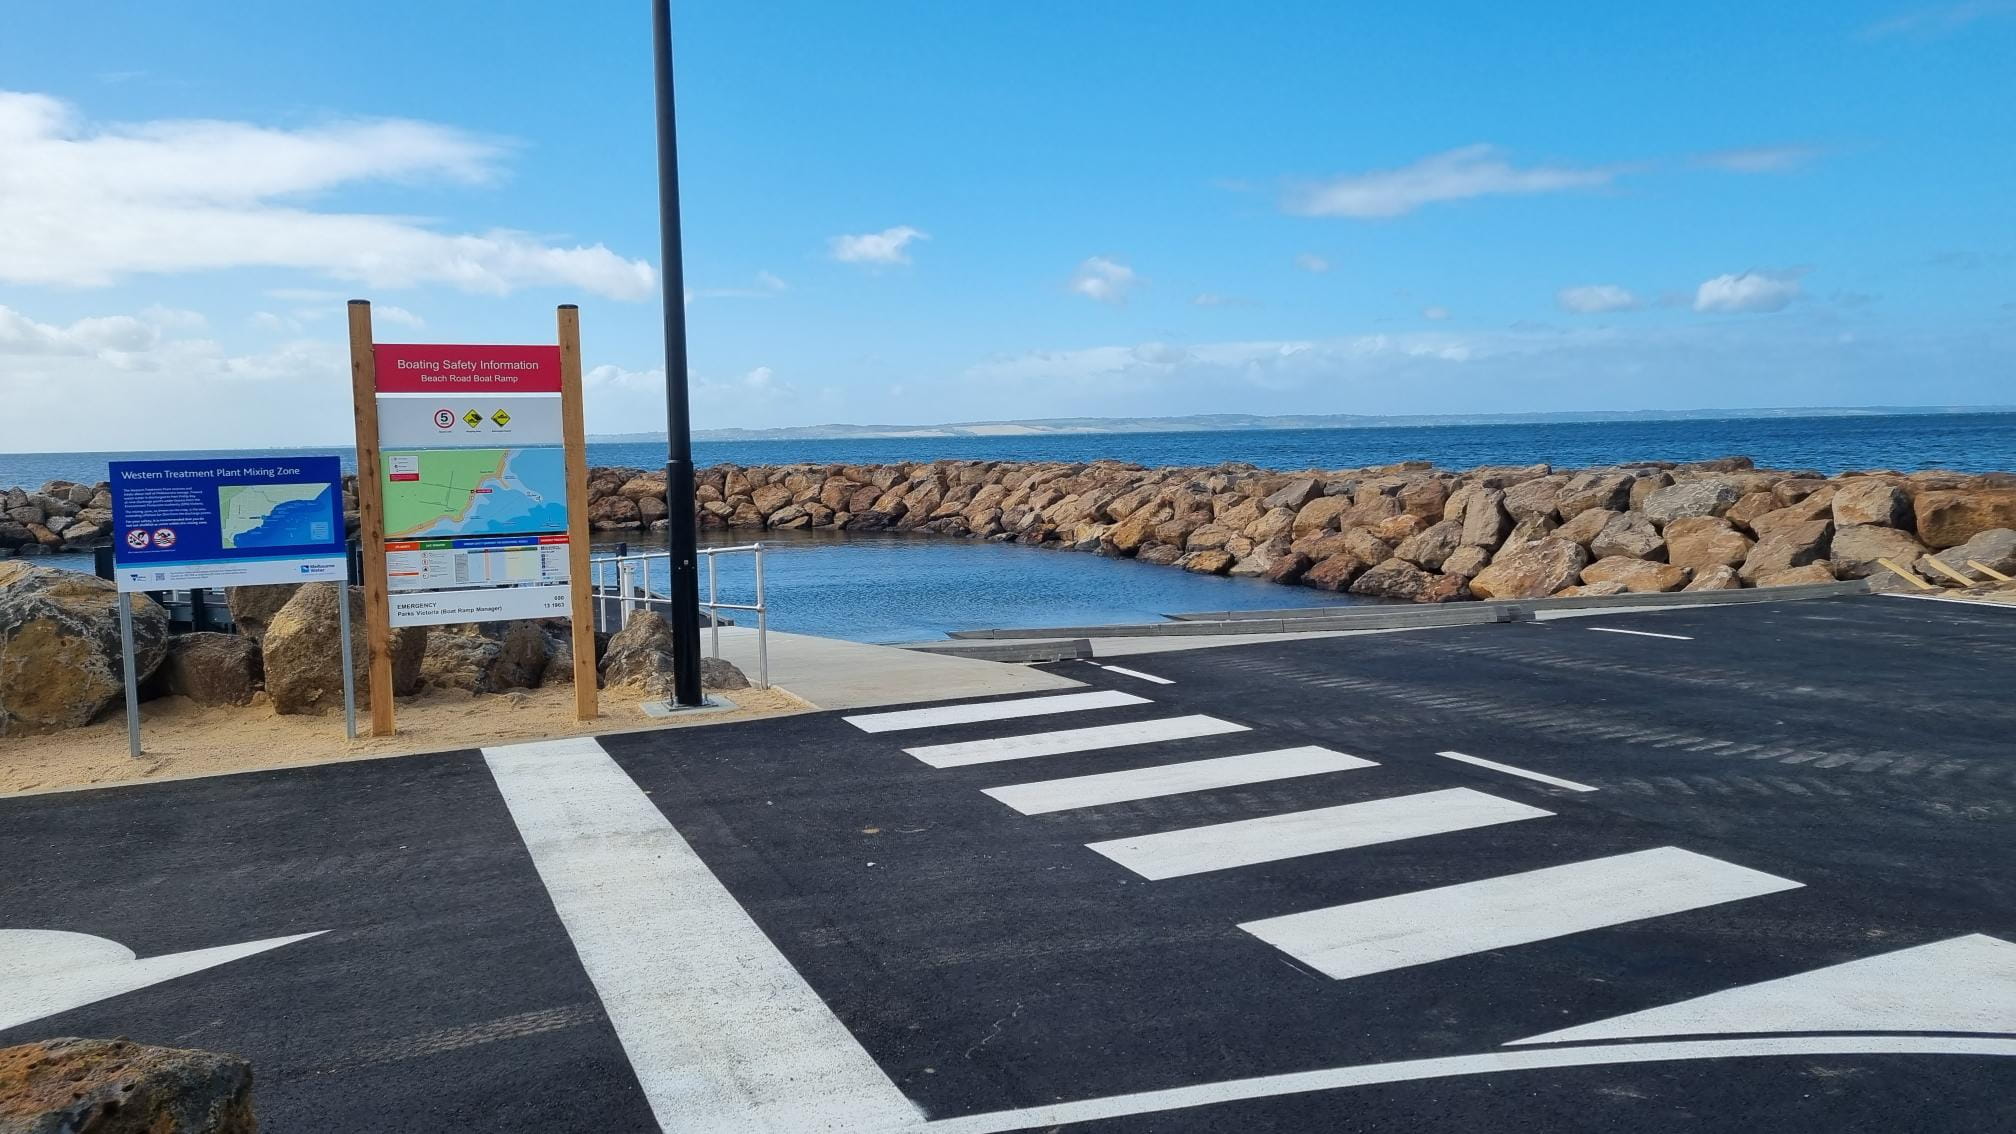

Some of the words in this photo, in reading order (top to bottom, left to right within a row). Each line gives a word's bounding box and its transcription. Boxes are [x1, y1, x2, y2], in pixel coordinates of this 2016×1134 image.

[397, 359, 440, 372] Boating
[443, 359, 477, 372] Safety
[480, 359, 539, 370] Information
[421, 374, 448, 382] Beach
[449, 374, 472, 382] Road
[473, 374, 492, 382] Boat
[494, 374, 519, 384] Ramp
[440, 412, 449, 423] 5
[121, 471, 162, 479] Western
[164, 469, 214, 479] Treatment
[216, 467, 241, 477] Plant
[243, 467, 275, 478] Mixing
[277, 466, 301, 476] Zone
[397, 602, 437, 610] EMERGENCY
